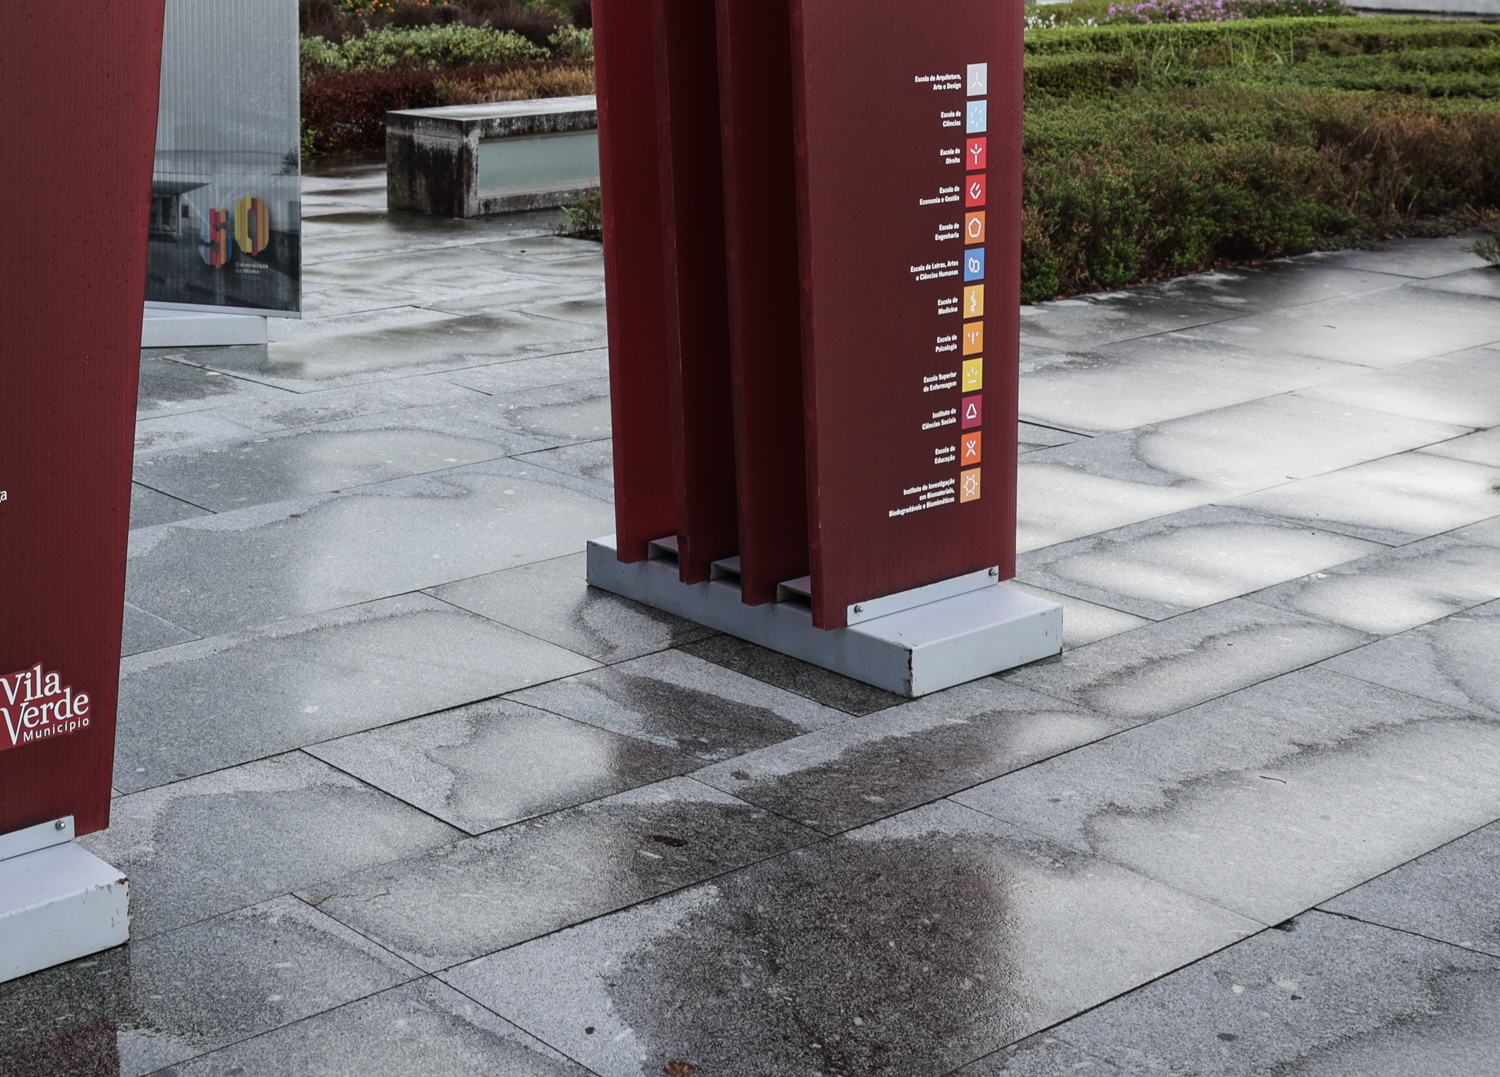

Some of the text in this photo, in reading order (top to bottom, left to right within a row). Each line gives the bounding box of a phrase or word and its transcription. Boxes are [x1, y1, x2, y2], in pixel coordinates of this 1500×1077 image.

[199, 195, 269, 268] 50
[0, 665, 62, 706] Vila
[1, 688, 89, 746] Verde
[23, 716, 90, 742] Município
